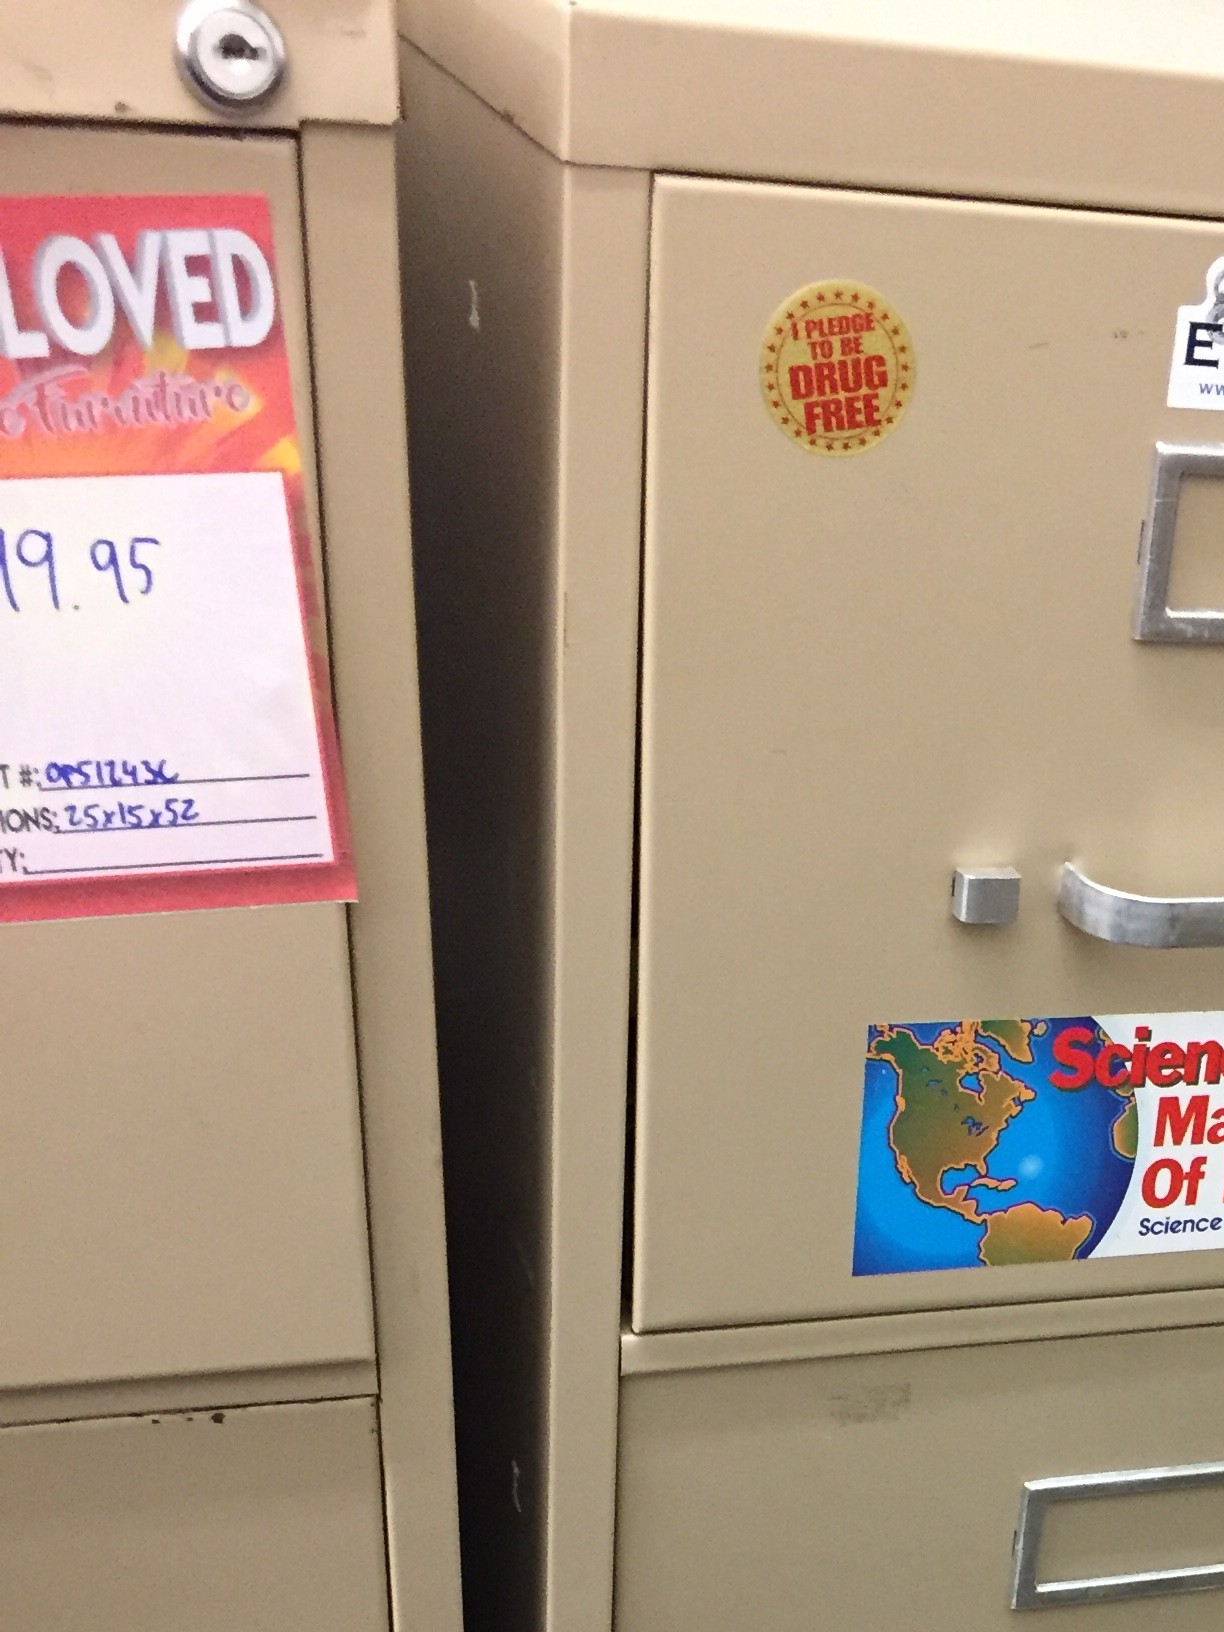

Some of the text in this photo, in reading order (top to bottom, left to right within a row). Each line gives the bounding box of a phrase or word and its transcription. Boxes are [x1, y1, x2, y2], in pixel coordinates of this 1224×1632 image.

[790, 312, 876, 341] I PLEDGE
[807, 336, 865, 361] TO BE
[788, 355, 889, 401] DRUG
[5, 364, 252, 434] Furniture
[803, 393, 882, 436] FREE
[64, 798, 200, 829] 25x15x52
[1140, 1155, 1208, 1209] Of
[1138, 1215, 1223, 1237] Science
